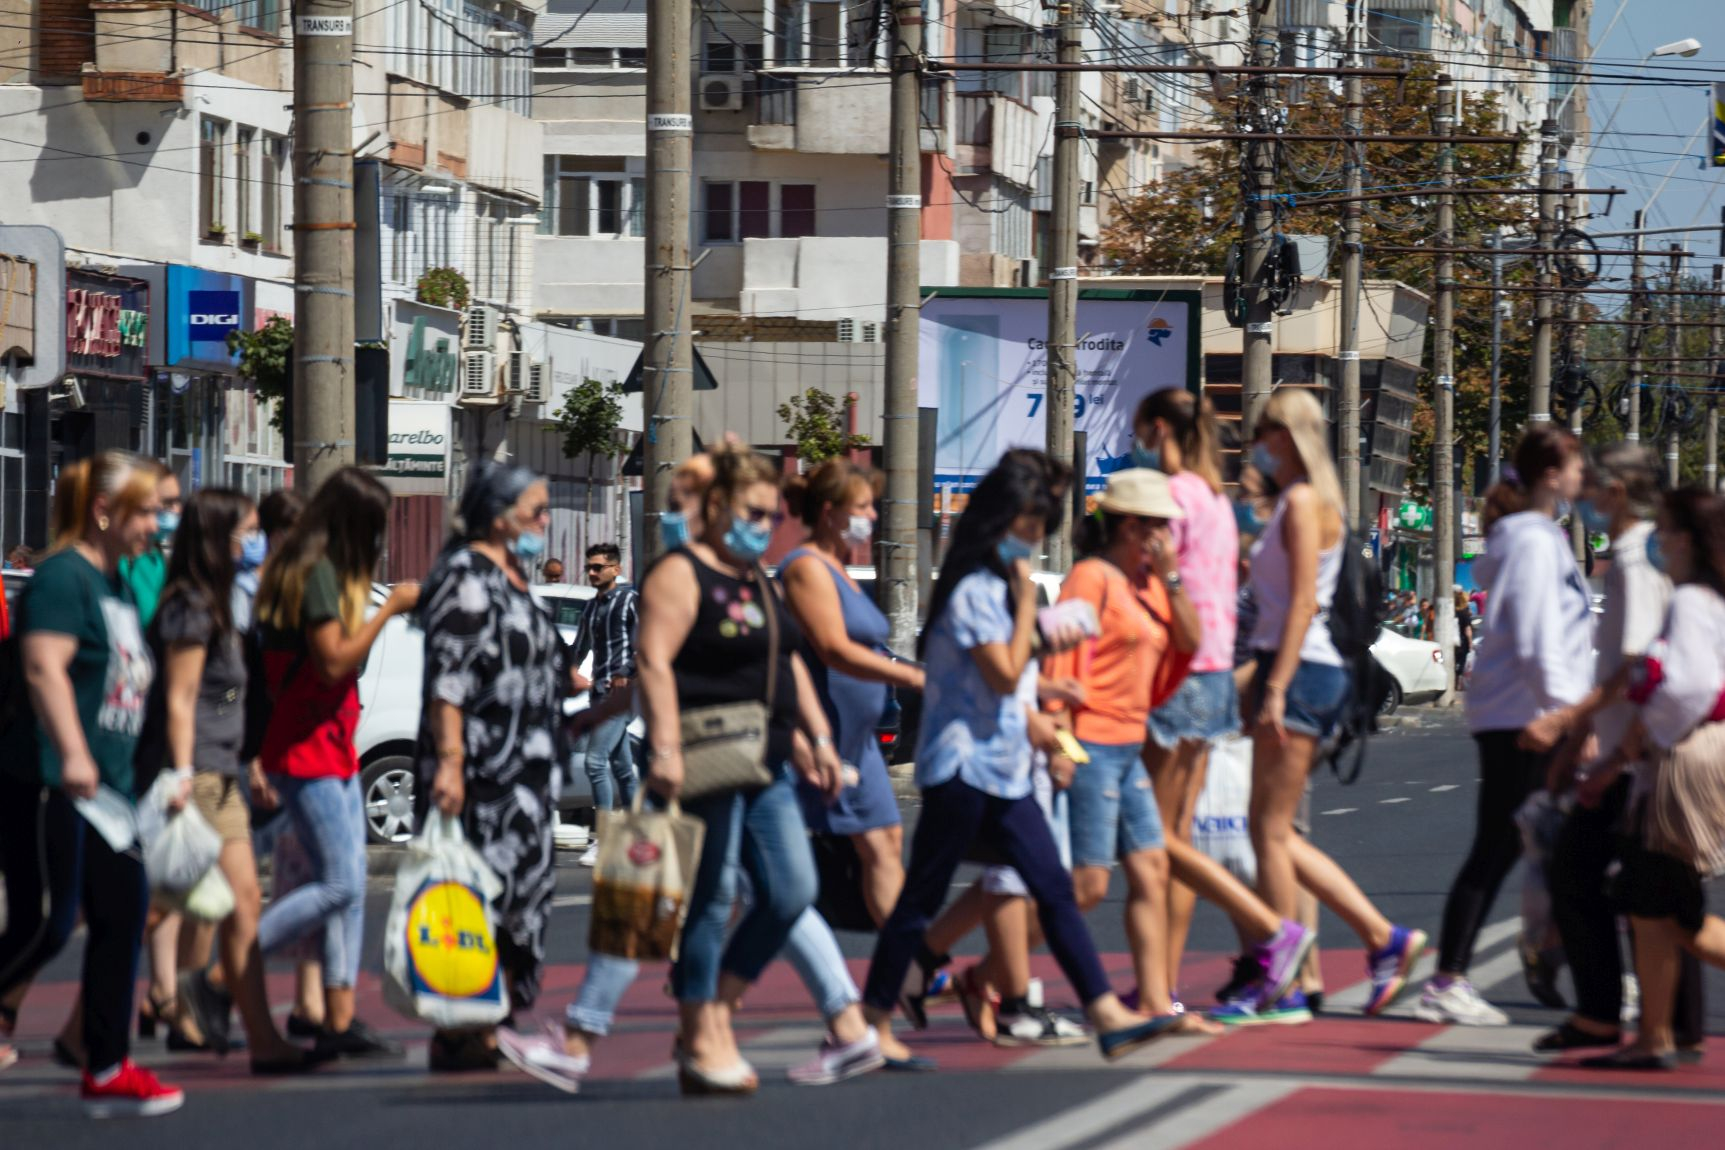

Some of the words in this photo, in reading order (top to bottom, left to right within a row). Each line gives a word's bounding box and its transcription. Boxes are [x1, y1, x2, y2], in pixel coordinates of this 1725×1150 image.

[303, 18, 345, 32] TRANSURB
[190, 314, 239, 325] DIGI
[1026, 393, 1086, 418] 79
[1088, 394, 1105, 405] lei
[387, 429, 444, 444] arelbo
